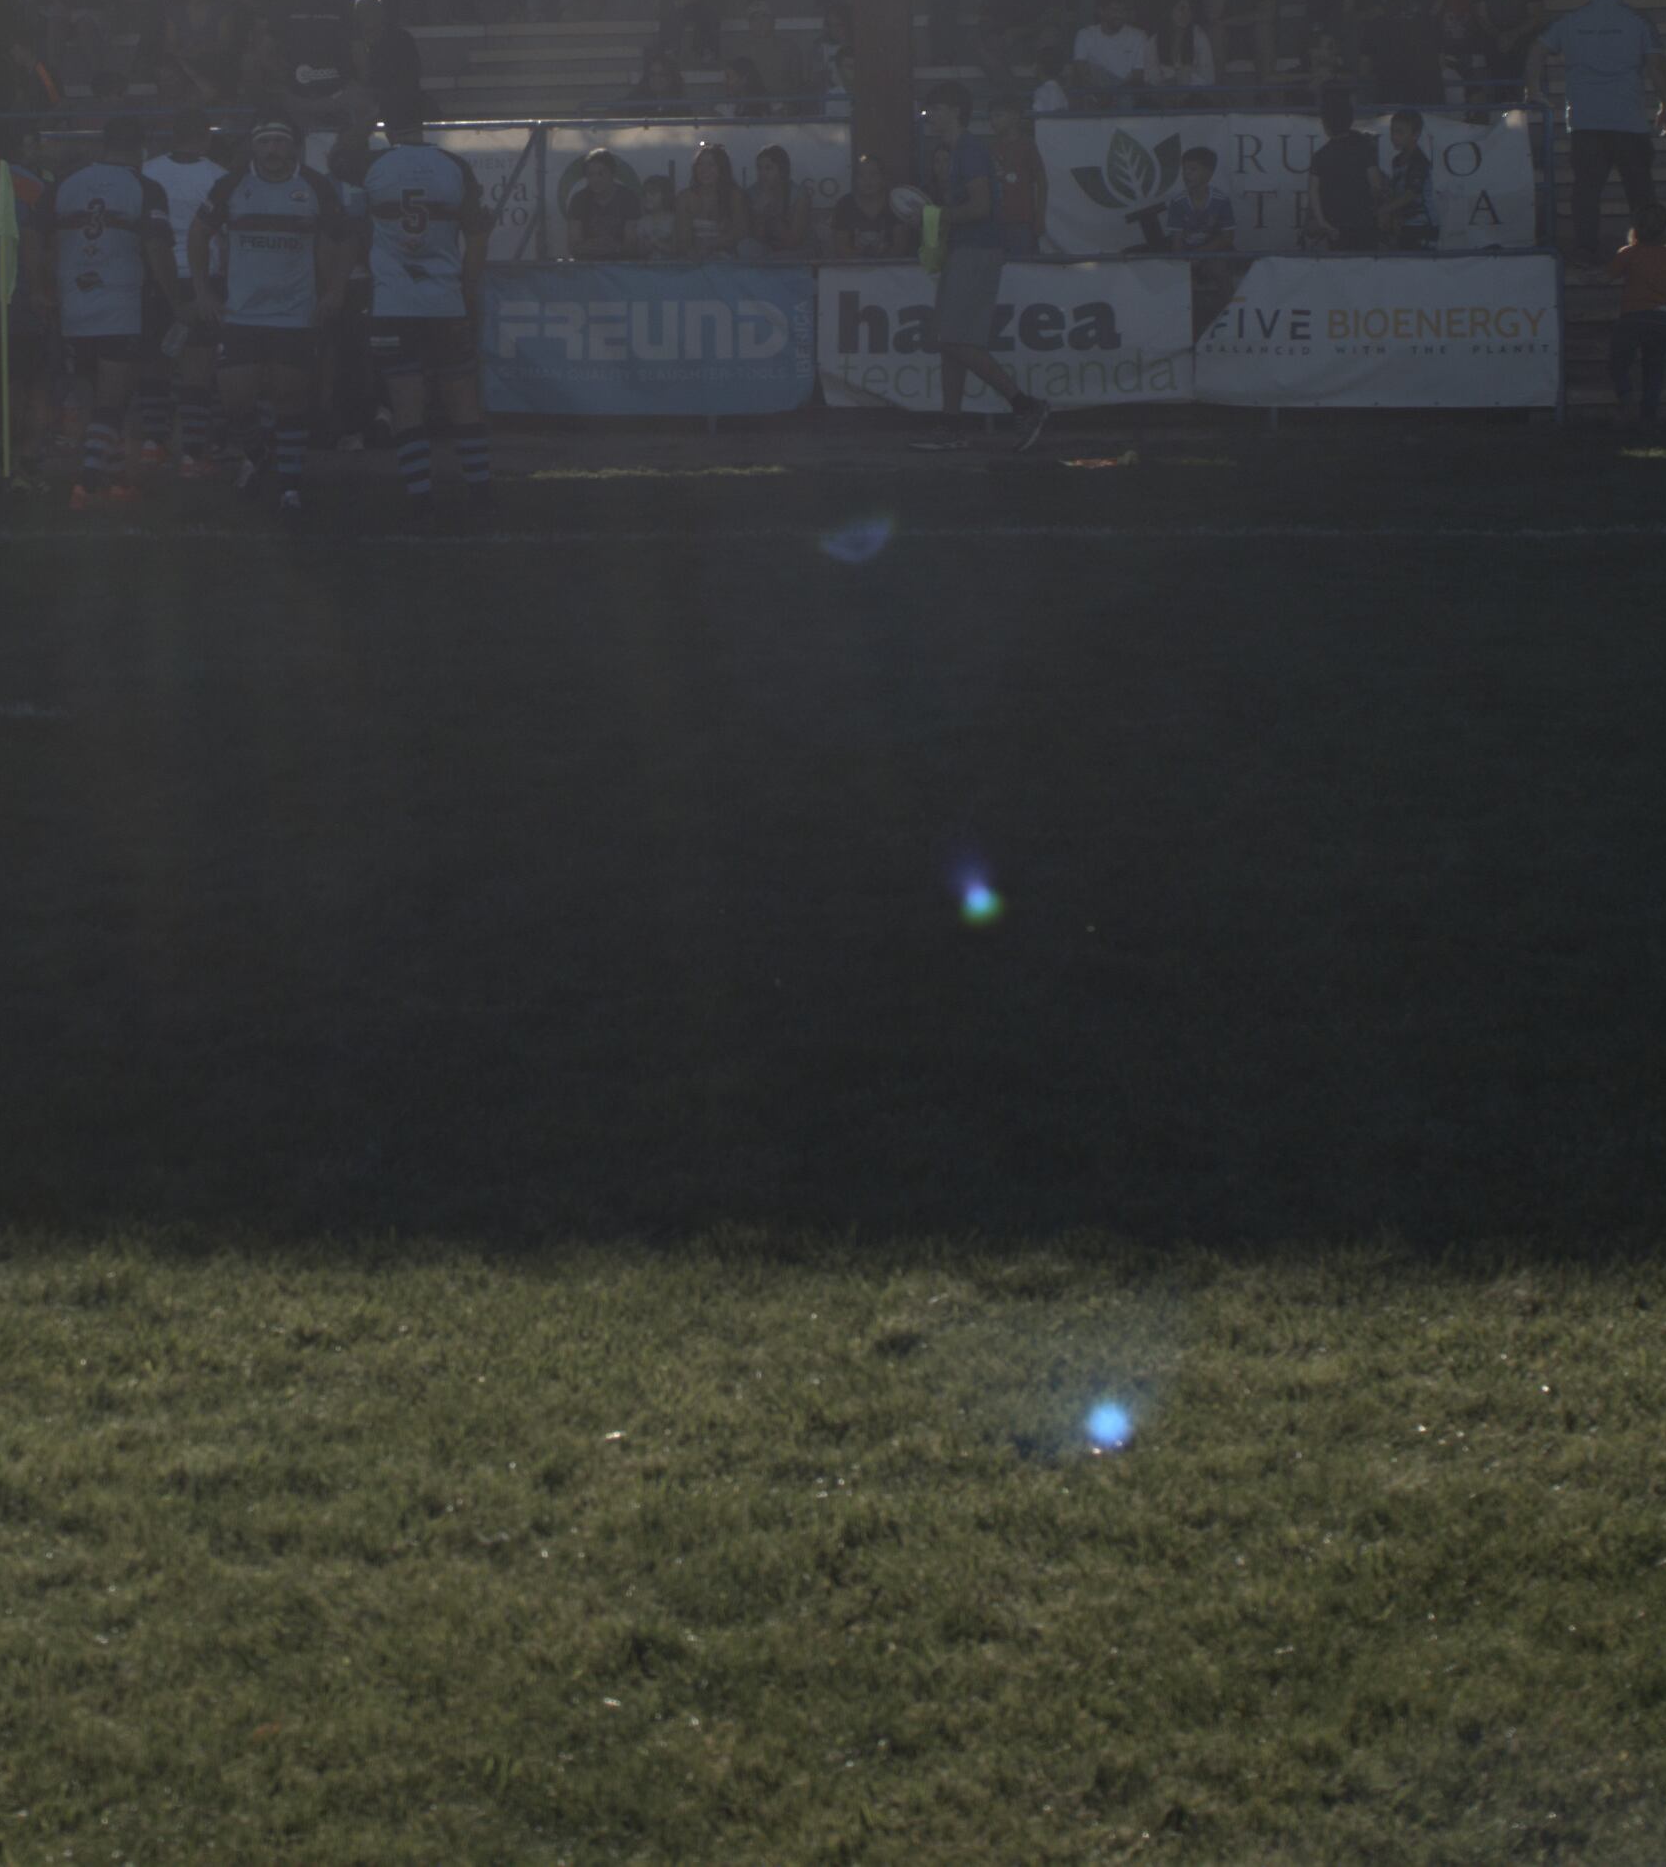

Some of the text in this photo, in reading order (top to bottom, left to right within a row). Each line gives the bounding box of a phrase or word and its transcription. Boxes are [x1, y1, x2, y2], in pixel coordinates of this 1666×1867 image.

[82, 196, 109, 242] 3
[401, 187, 430, 235] 5
[498, 299, 789, 361] FREUND
[838, 290, 1124, 355] hazea
[1327, 306, 1547, 340] BIOENERGY
[1205, 344, 1311, 356] BALANCED
[1335, 344, 1387, 356] WITH
[1411, 345, 1447, 356] THE
